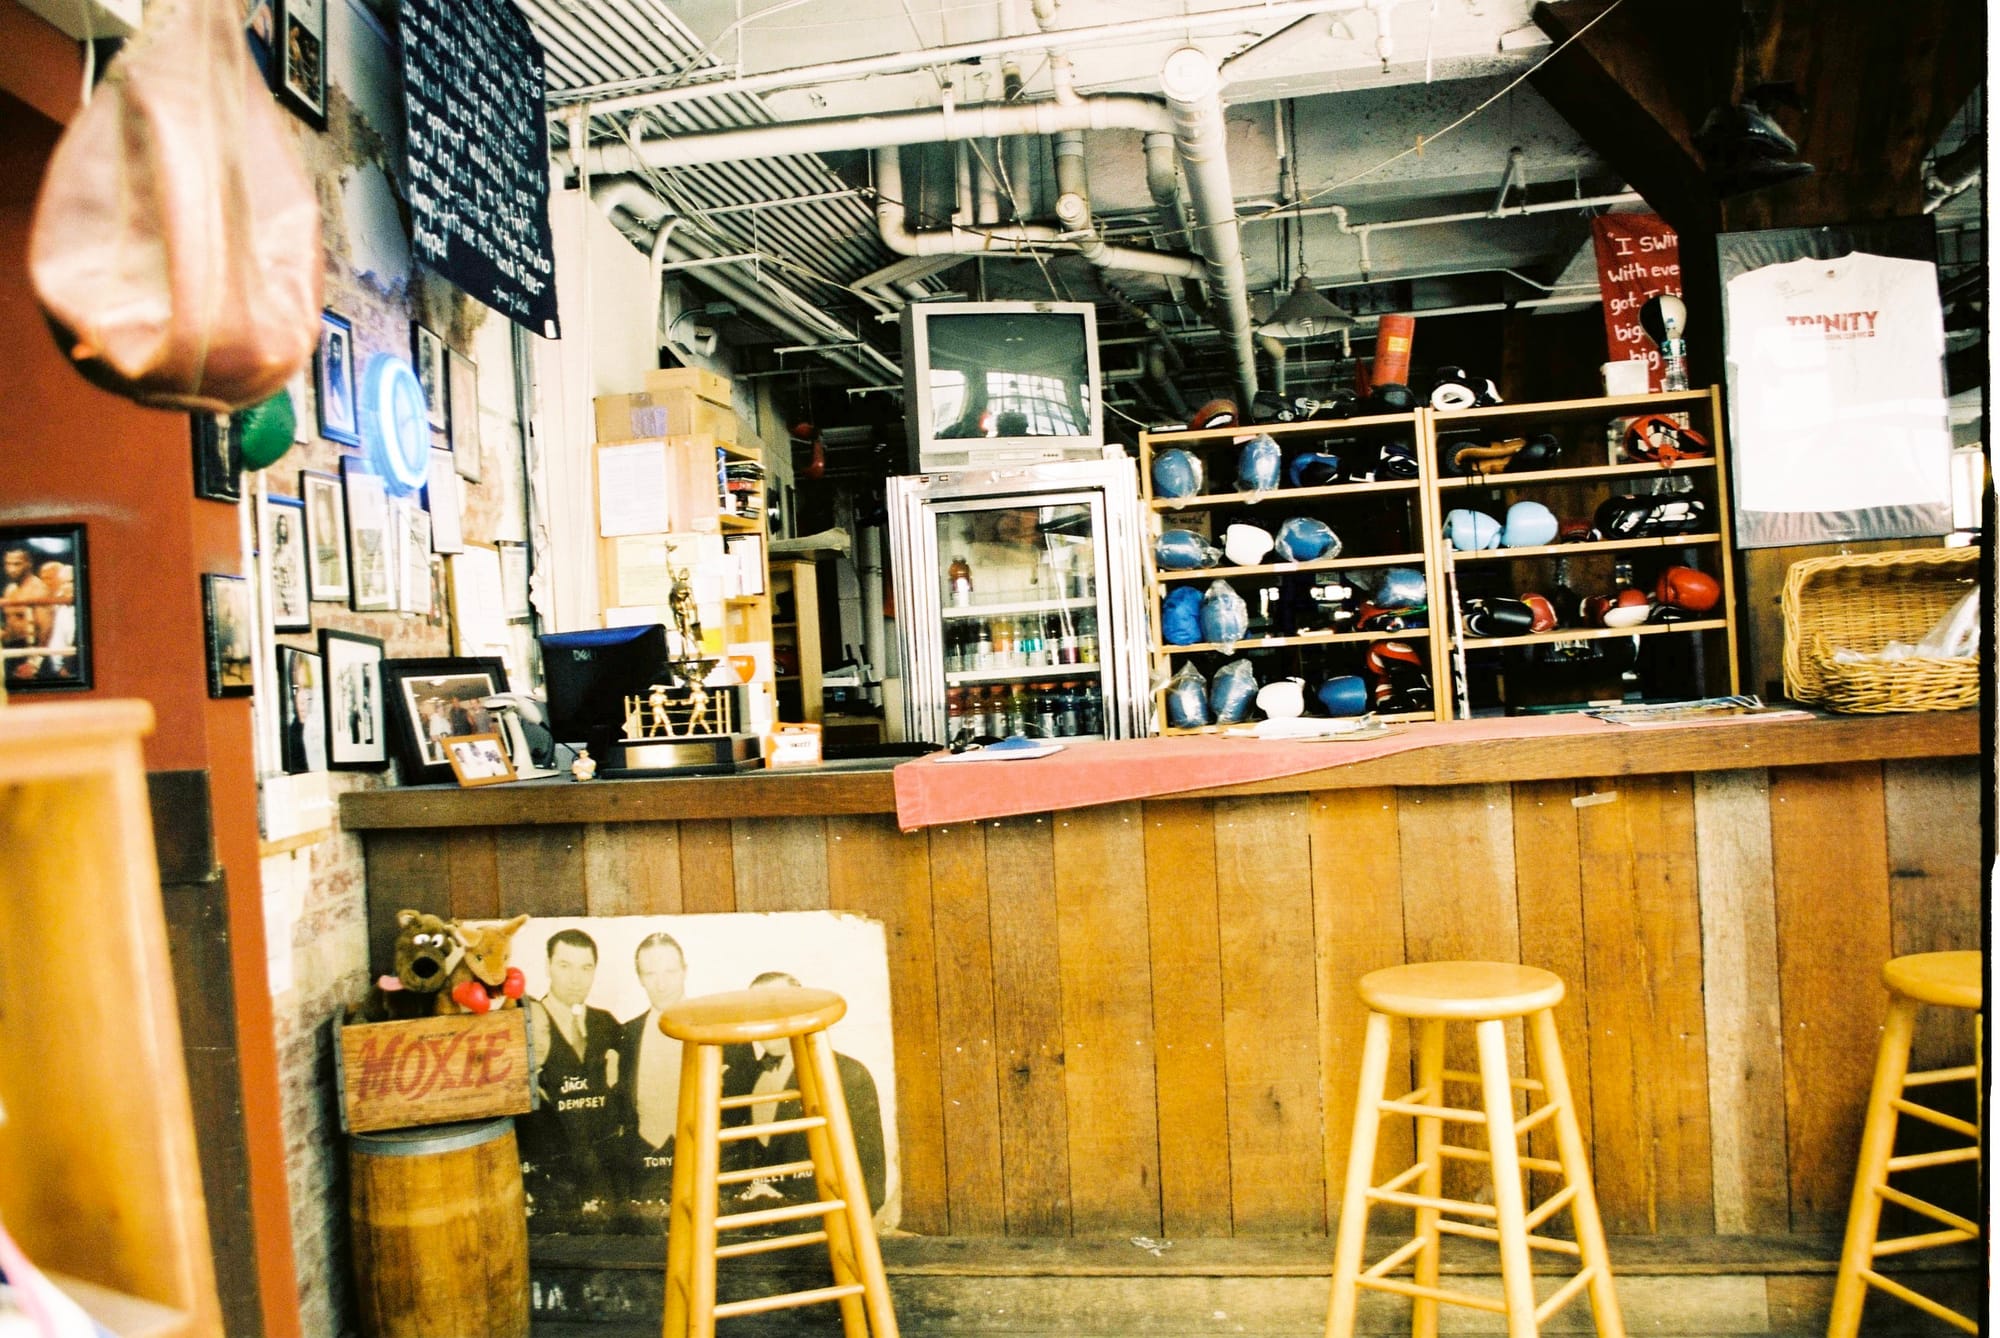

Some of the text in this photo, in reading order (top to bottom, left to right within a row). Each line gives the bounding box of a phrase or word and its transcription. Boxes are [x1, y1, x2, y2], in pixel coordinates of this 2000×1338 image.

[357, 1027, 513, 1102] MOXIE
[560, 1077, 589, 1094] JACK
[558, 1096, 605, 1111] DEMPSEY
[643, 1156, 673, 1168] TONY
